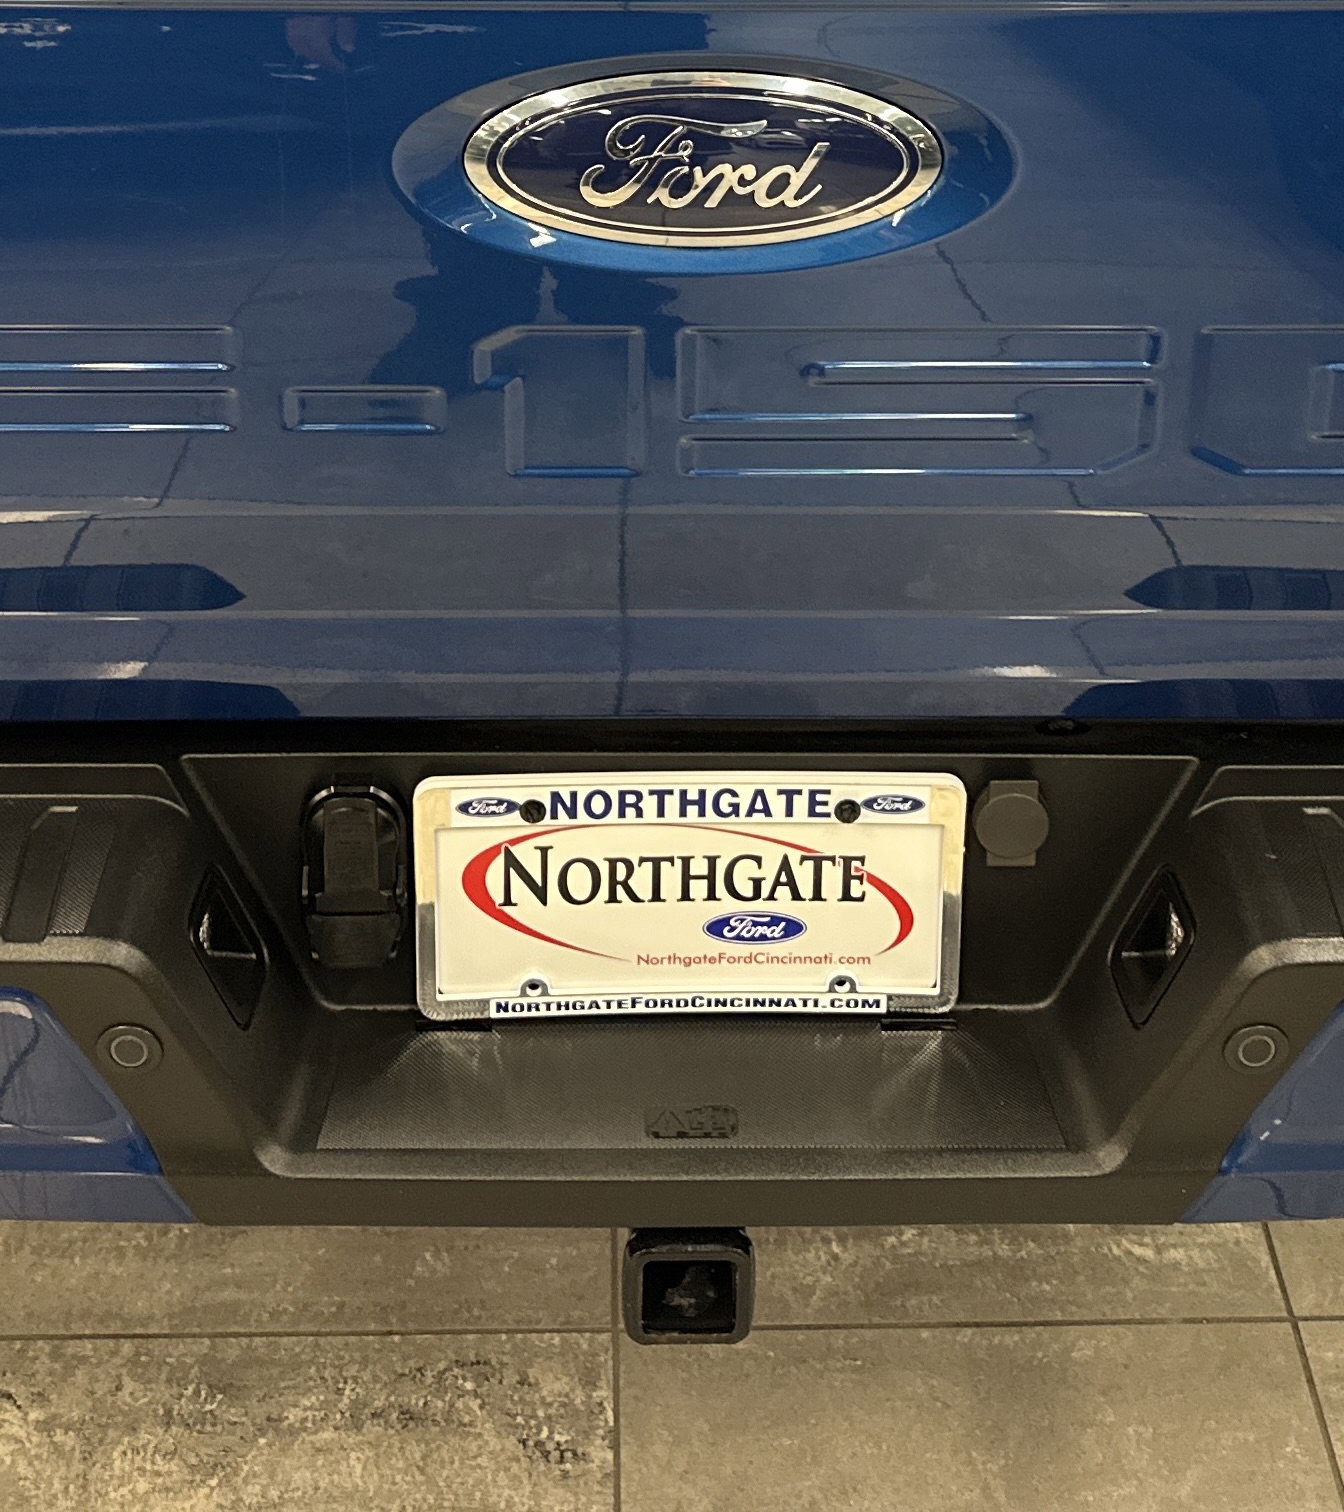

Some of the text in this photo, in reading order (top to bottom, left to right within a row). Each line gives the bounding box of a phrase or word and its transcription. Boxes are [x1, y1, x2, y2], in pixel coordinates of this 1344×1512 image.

[580, 114, 830, 208] Ford
[468, 799, 507, 814] Ford
[550, 788, 832, 820] NORTHGATE
[873, 797, 912, 810] Ford
[498, 845, 867, 907] NORTHGATE
[723, 916, 786, 938] Ford
[636, 952, 872, 968] NorthgateFordCincinnati.com
[495, 994, 882, 1014] NORTHGATEFORDCINCINNATI.COM
